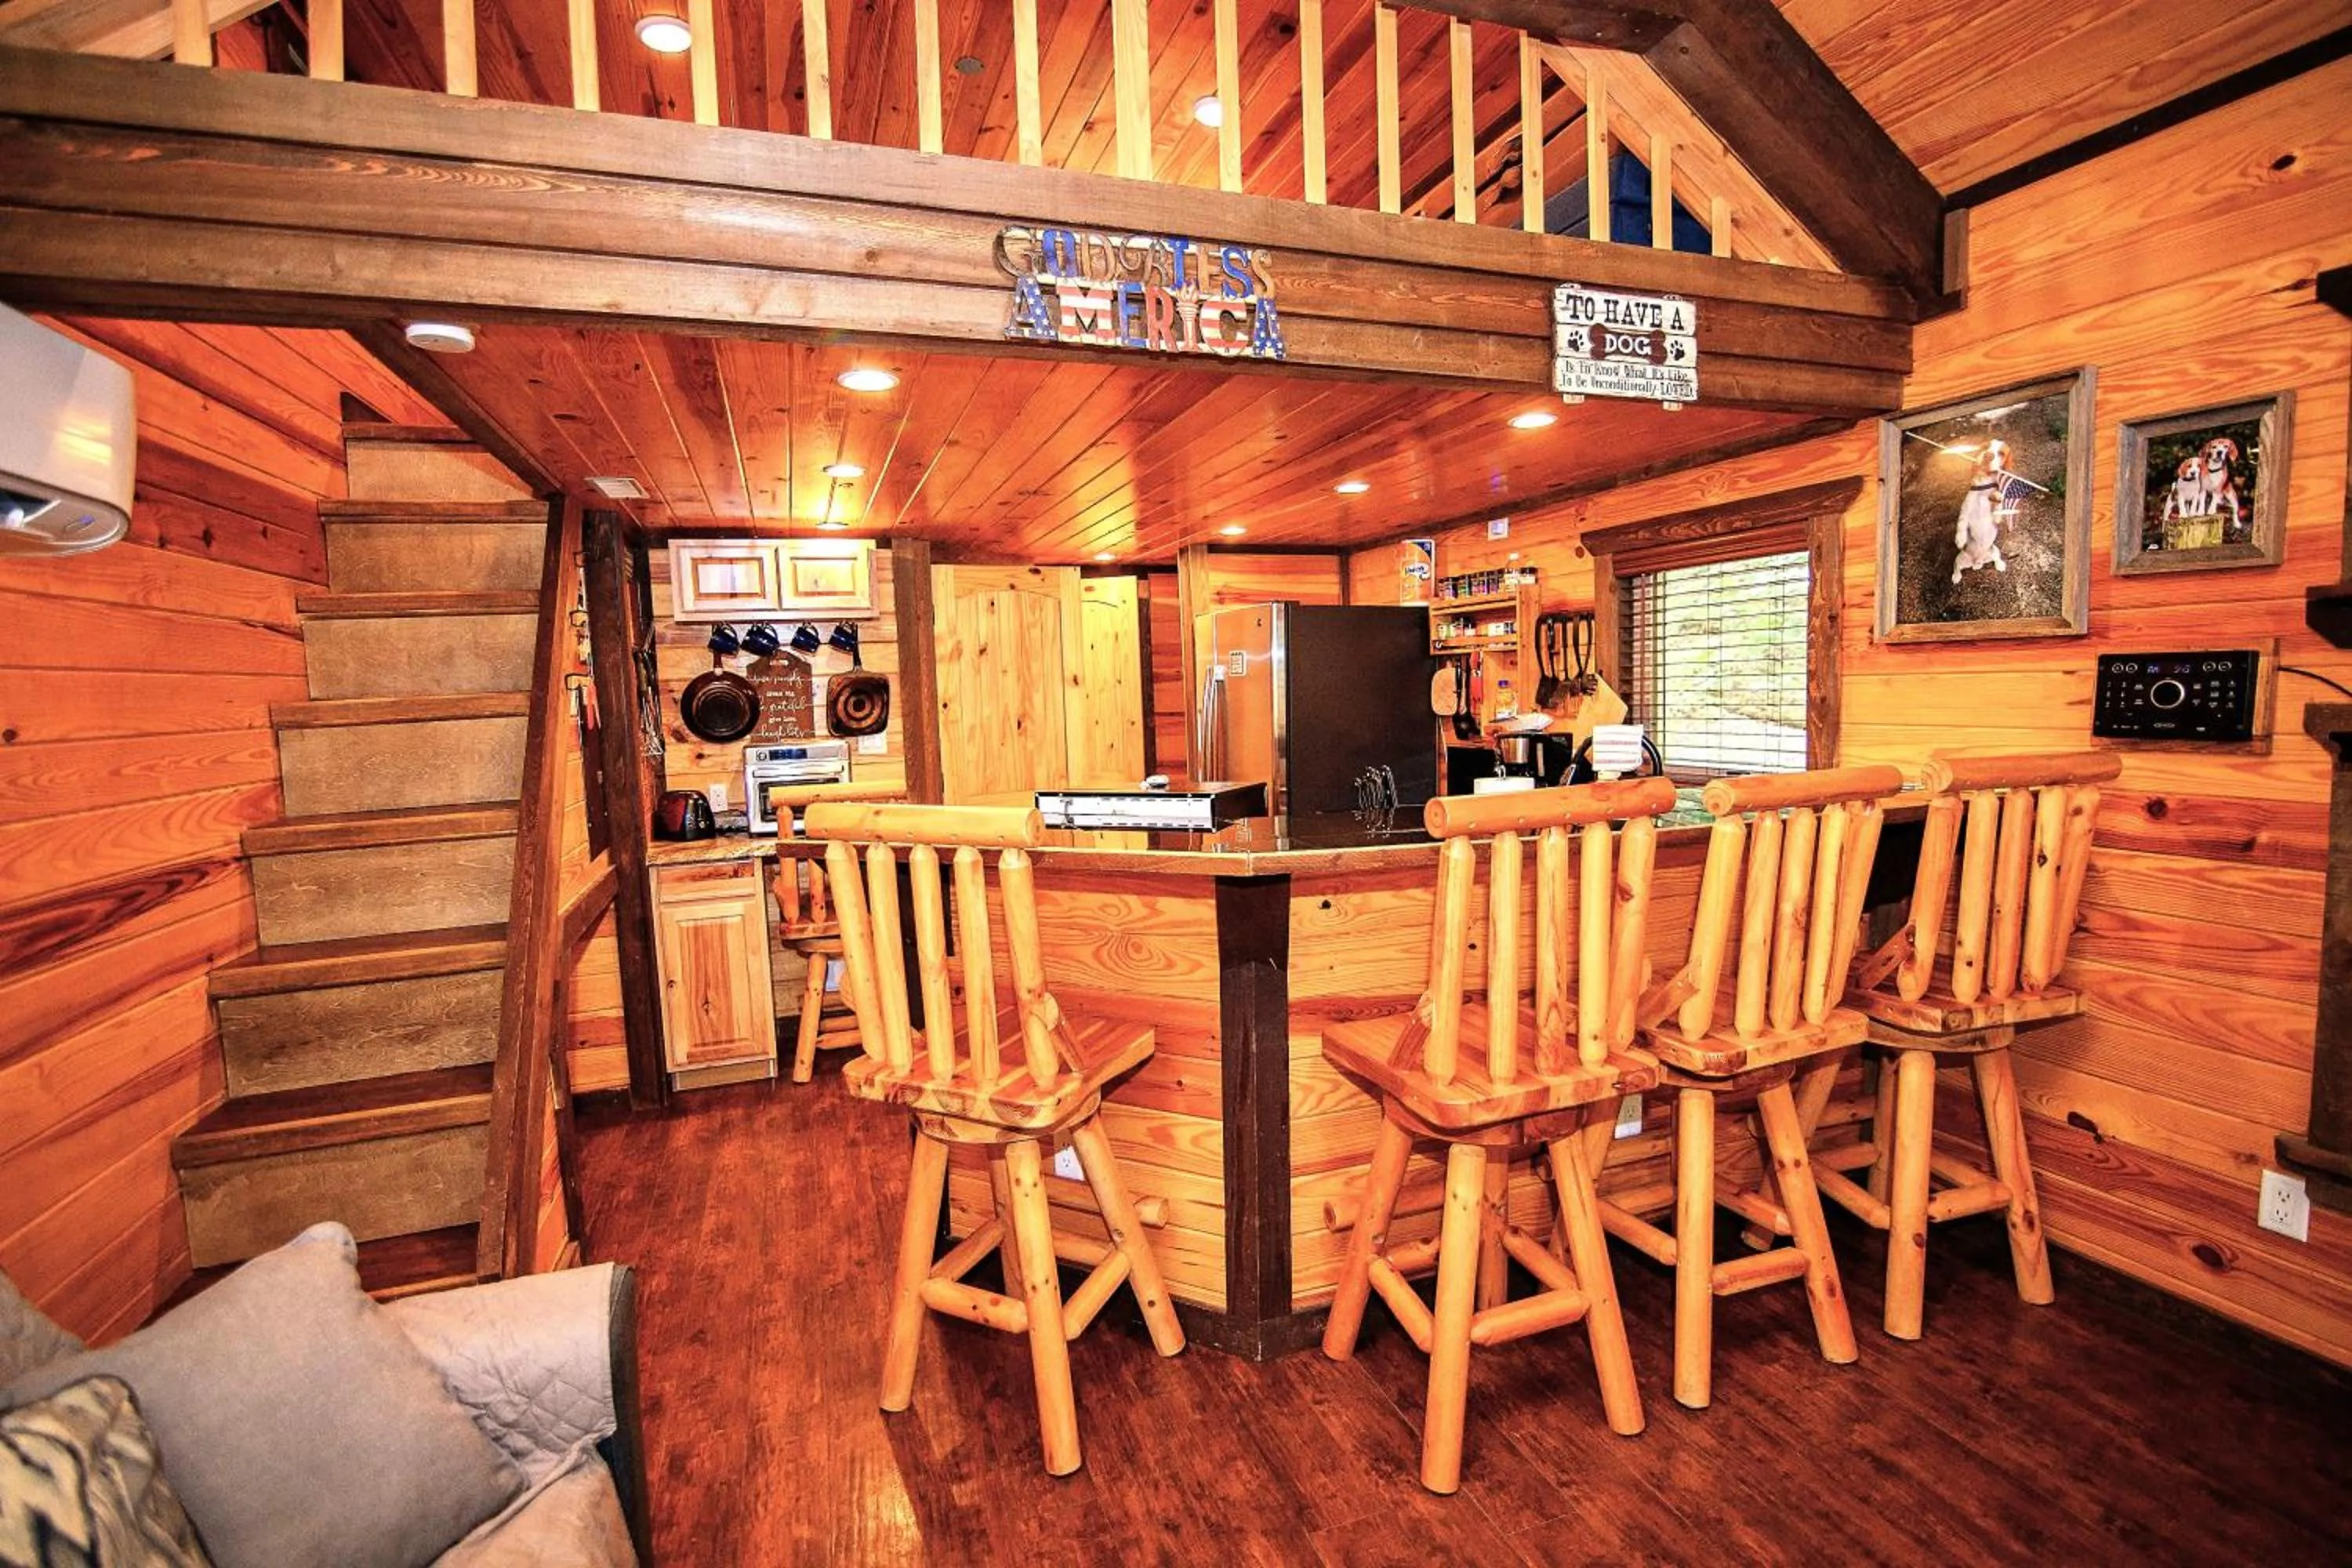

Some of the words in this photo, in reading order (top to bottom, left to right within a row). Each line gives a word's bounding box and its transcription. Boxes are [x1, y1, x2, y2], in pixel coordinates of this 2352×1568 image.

[1004, 274, 1287, 361] AMERICA
[1566, 294, 1595, 321] TO
[1604, 299, 1663, 328] HAVE
[1671, 307, 1685, 330] A
[1606, 333, 1651, 355] DOG
